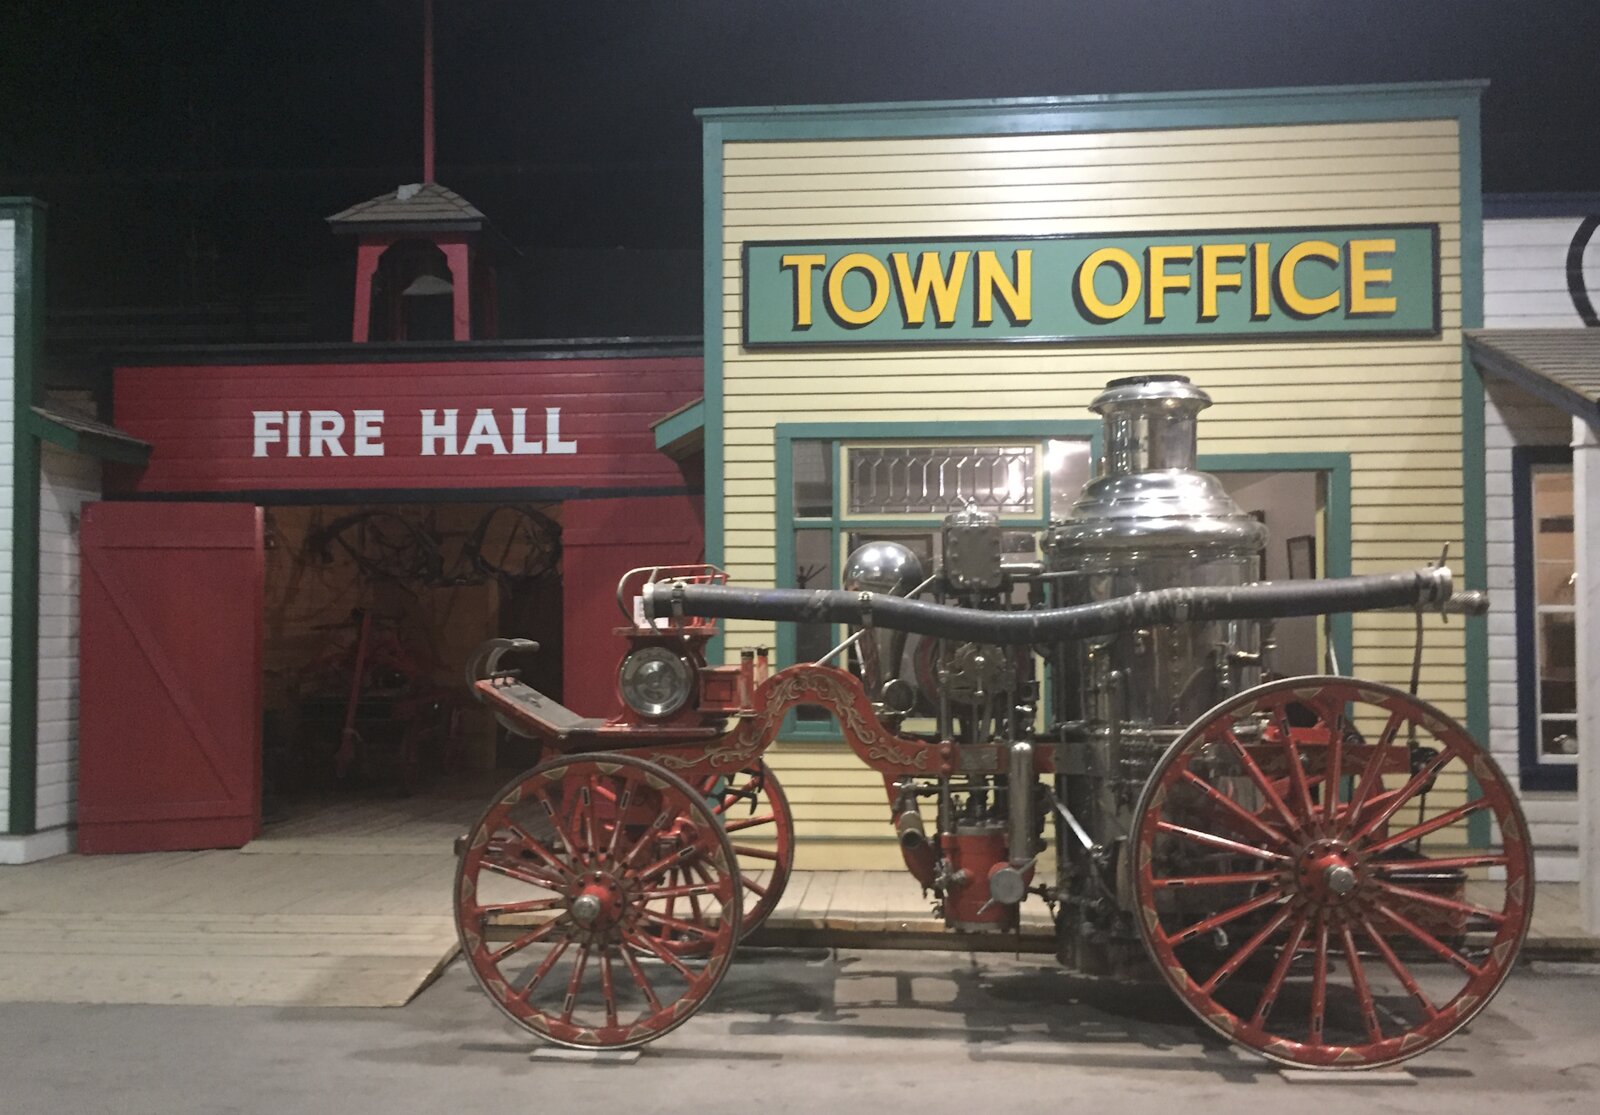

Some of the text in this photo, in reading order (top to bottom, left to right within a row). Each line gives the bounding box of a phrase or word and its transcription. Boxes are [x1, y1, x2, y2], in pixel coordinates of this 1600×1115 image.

[779, 239, 1397, 331] TOWN OFFICE
[252, 407, 577, 457] FIRE HALL
